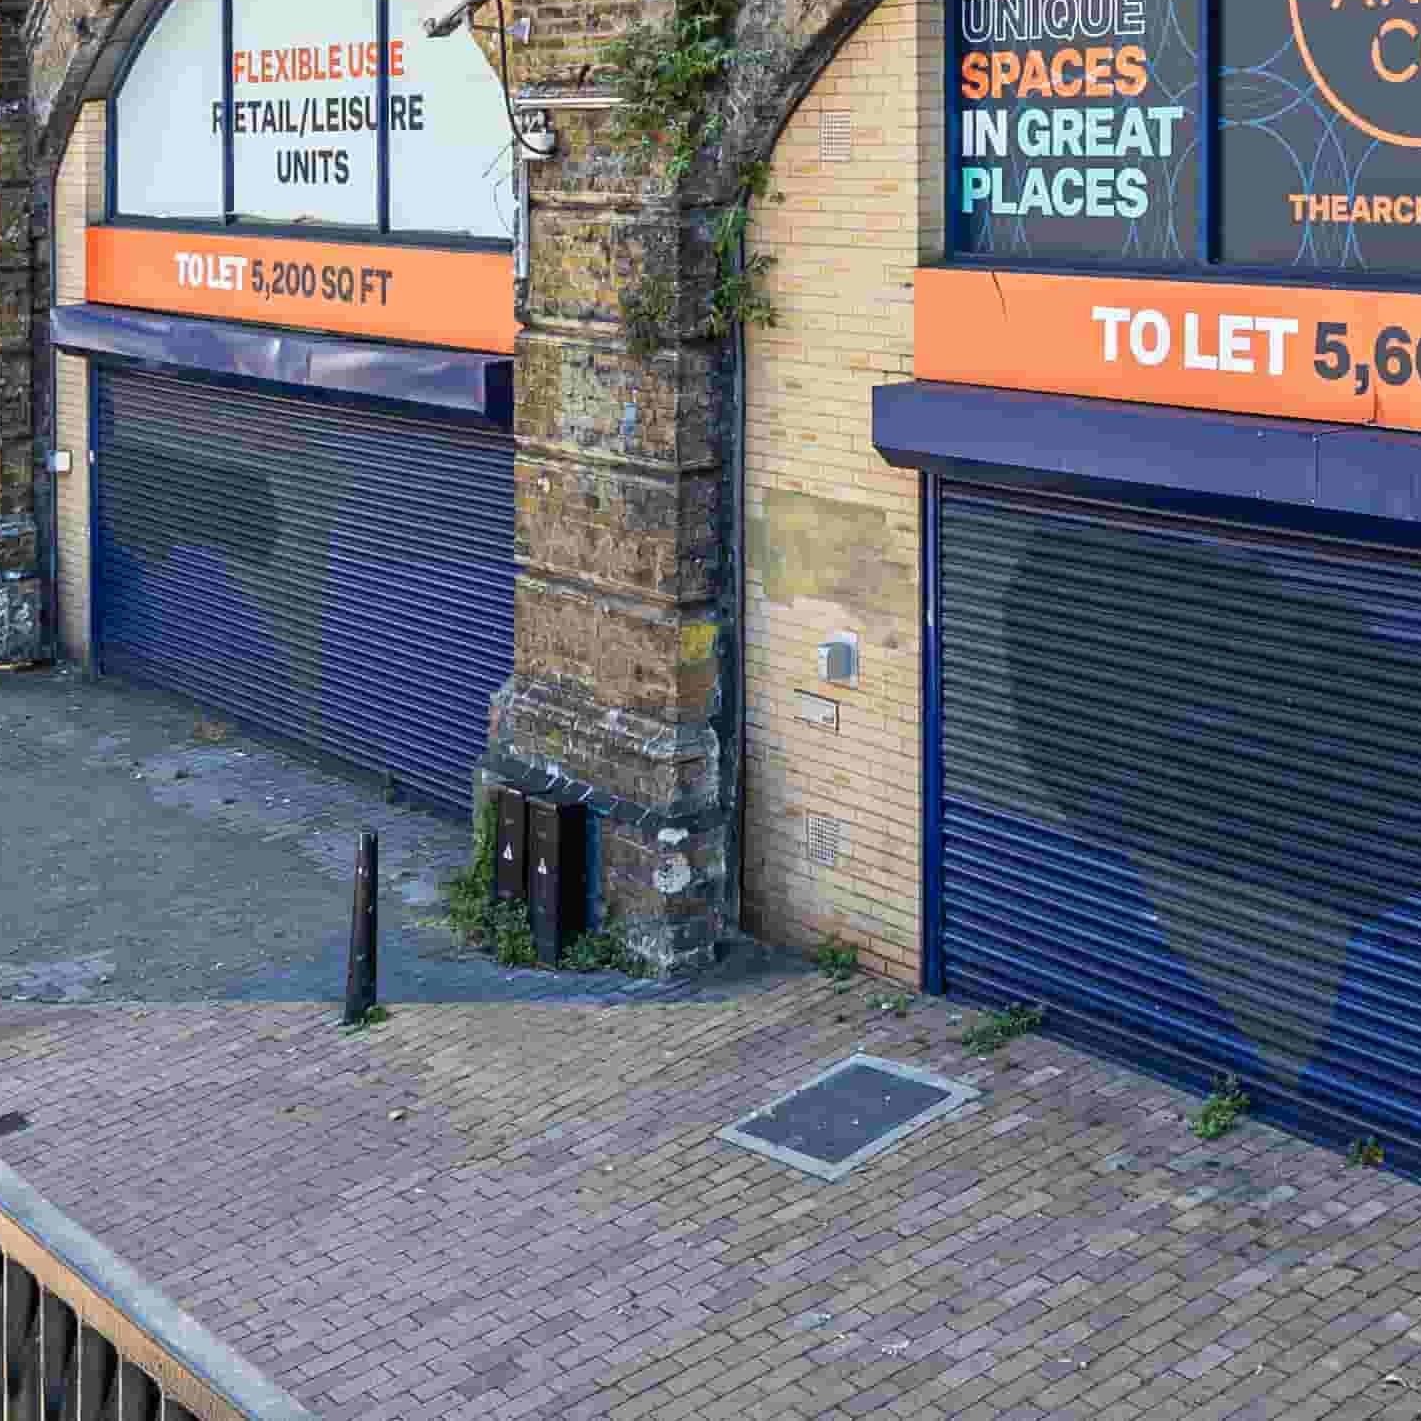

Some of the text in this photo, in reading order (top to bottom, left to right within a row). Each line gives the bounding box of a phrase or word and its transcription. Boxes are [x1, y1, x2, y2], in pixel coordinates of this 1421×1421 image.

[233, 41, 404, 83] FLEXIBLE USE
[962, 46, 1147, 99] SPACES
[212, 95, 424, 138] RETAIL/LEISURE
[962, 105, 1183, 157] IN GREAT
[276, 150, 350, 184] UNITS
[962, 167, 1148, 219] PLACES
[175, 253, 392, 306] TO LET 5,200 SQ FT
[1092, 306, 1171, 364] TO
[1184, 313, 1298, 376] LET
